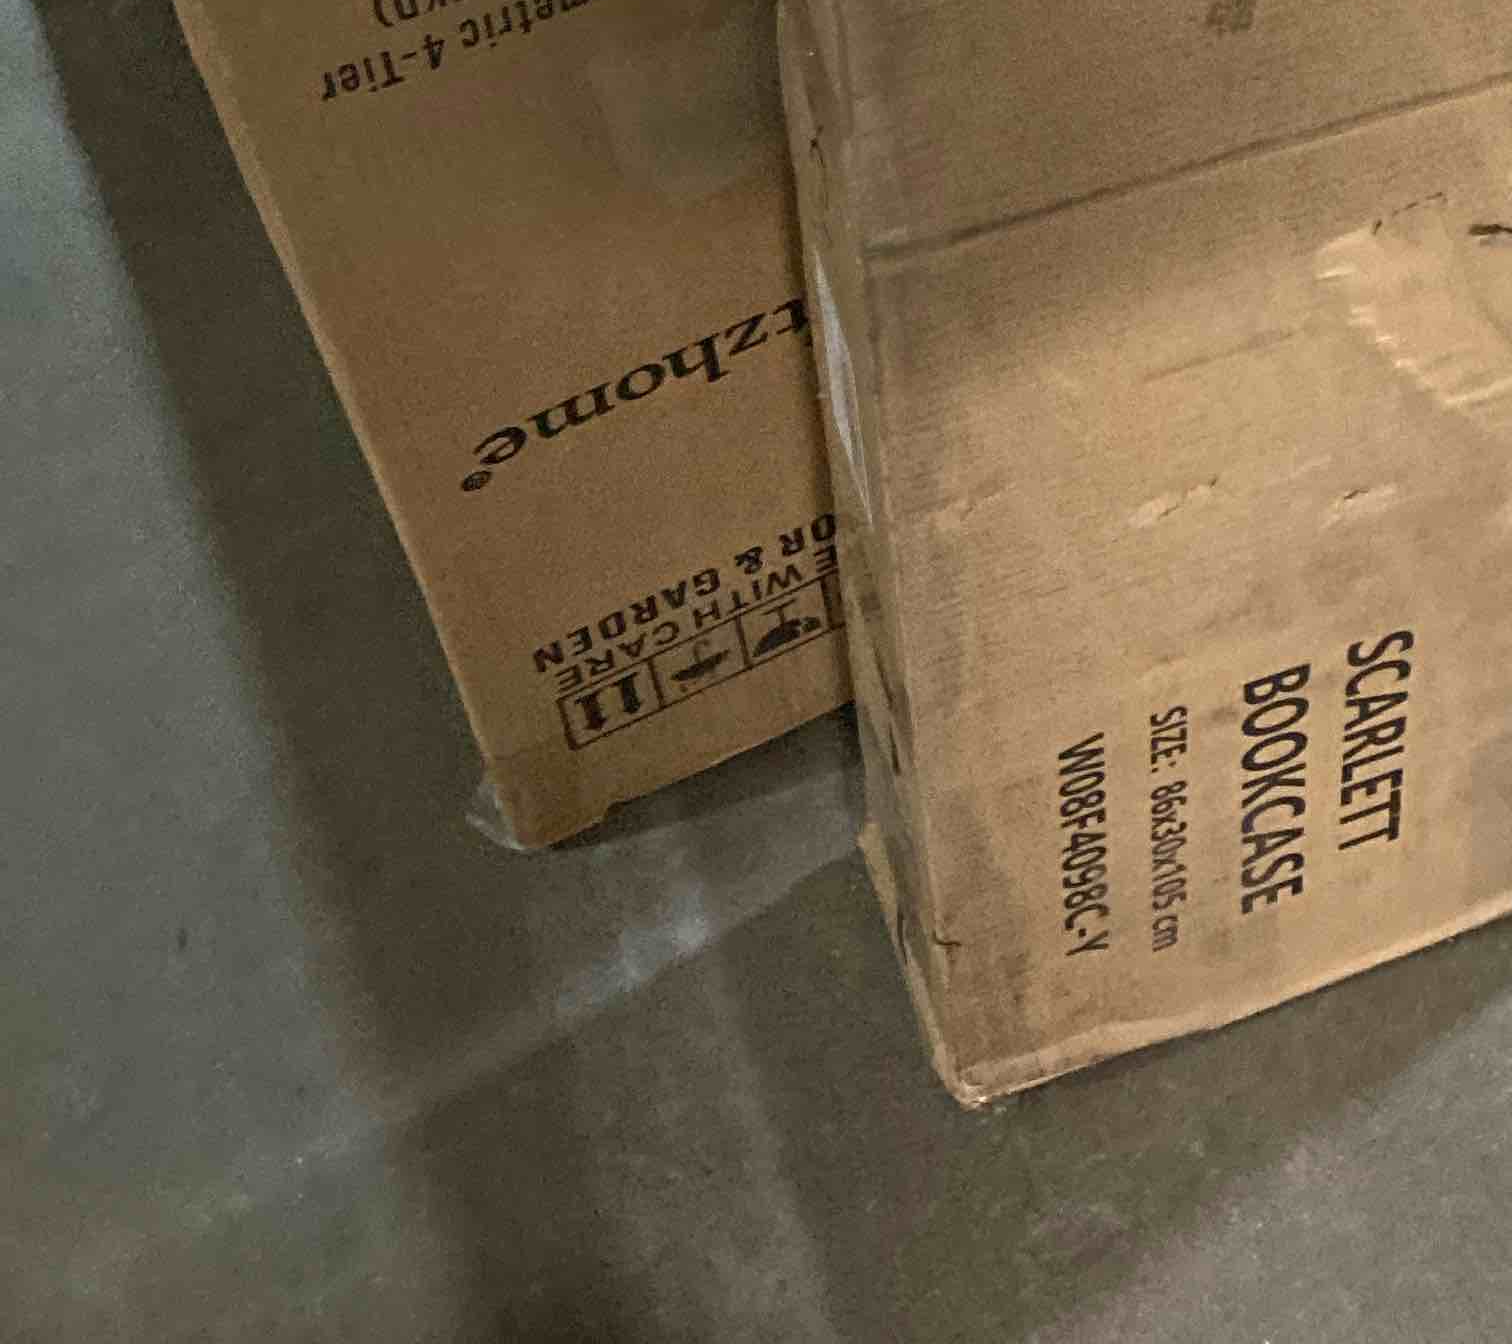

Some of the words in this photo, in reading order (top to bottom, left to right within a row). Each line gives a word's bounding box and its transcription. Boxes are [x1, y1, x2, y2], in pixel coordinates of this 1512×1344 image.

[320, 32, 446, 103] 4-Tier
[692, 563, 802, 628] WITH
[734, 545, 764, 574] &
[531, 567, 721, 674] GARDEN
[554, 621, 682, 694] CARE
[1149, 705, 1189, 775] SIZE:
[1338, 630, 1415, 851] SCARLETT
[1240, 663, 1312, 915] BOOKCASE
[1057, 731, 1112, 957] W08F4098C-Y
[1150, 780, 1188, 912] 86x30x105
[1151, 914, 1180, 954] cm
